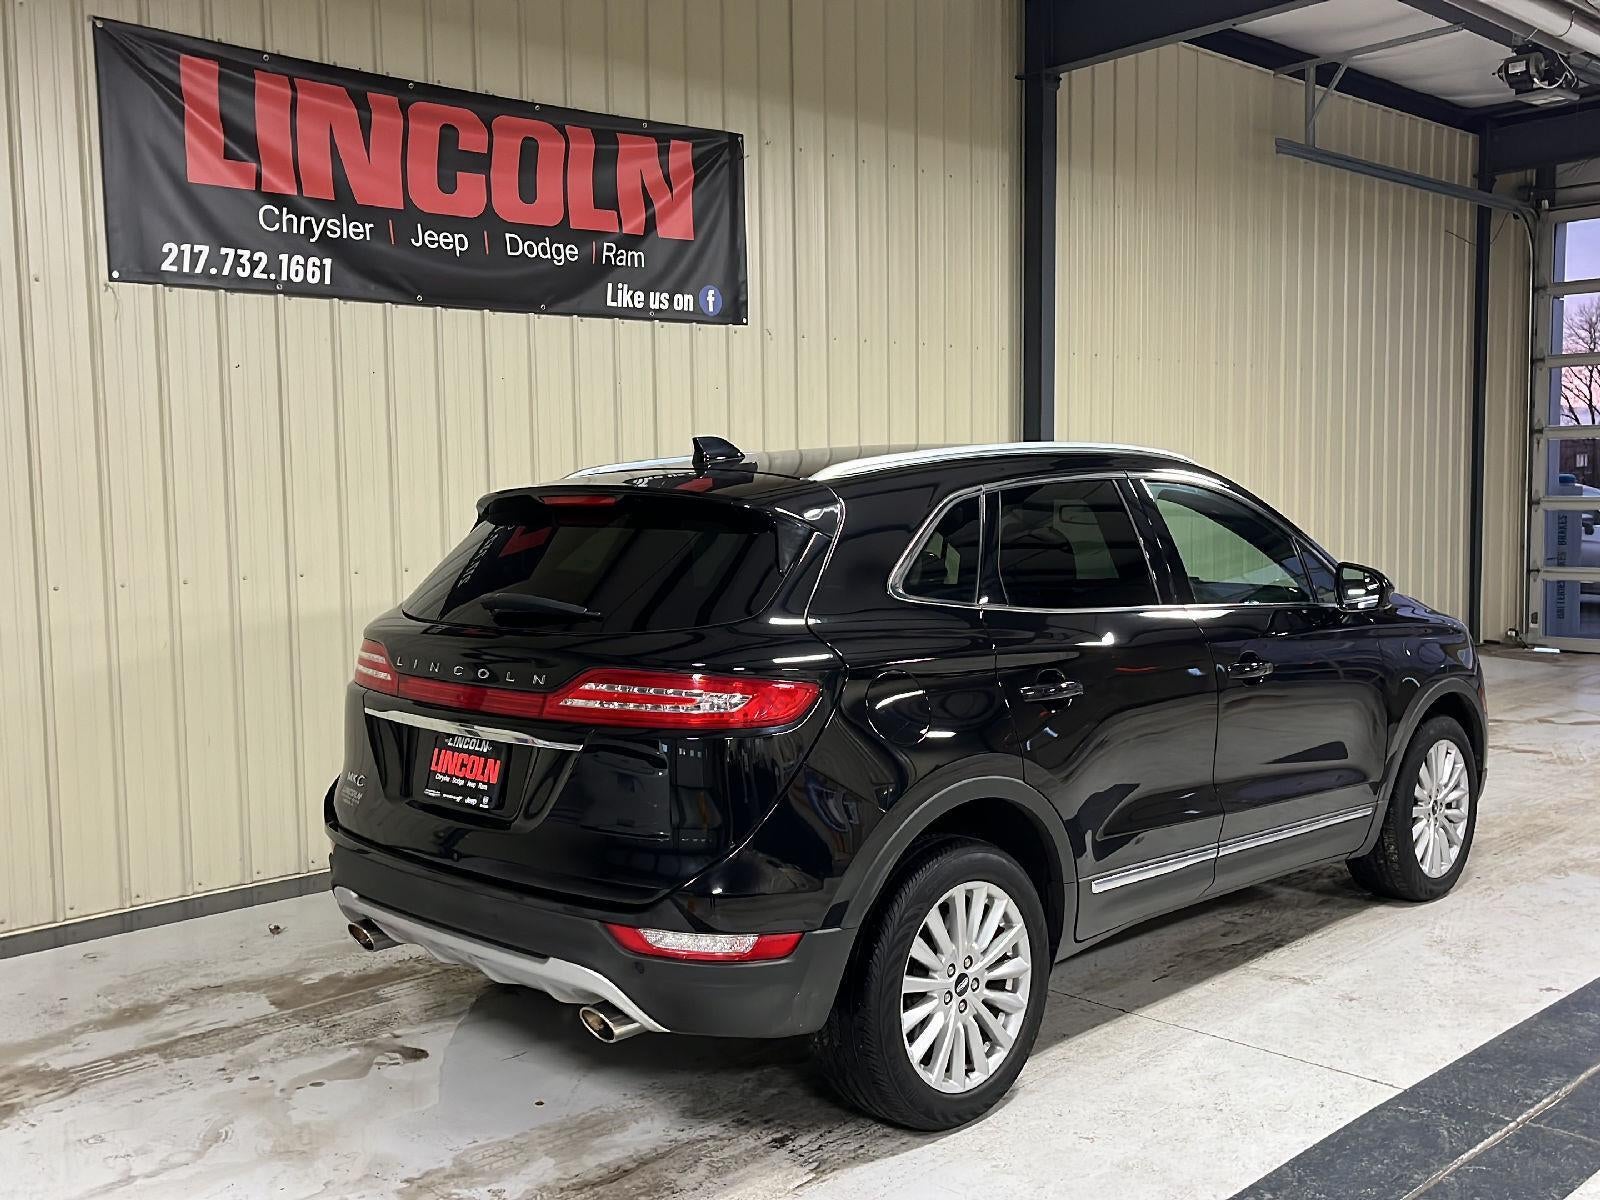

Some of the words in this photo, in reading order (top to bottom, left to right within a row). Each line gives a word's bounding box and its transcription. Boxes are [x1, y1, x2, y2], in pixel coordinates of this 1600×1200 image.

[178, 53, 695, 240] LINCOLN
[258, 204, 374, 243] Chrysler
[410, 223, 469, 257] Jeep
[504, 232, 579, 266] Dodge
[602, 242, 645, 268] Ram
[160, 242, 333, 285] 217.732.1661
[606, 282, 645, 309] Like
[649, 291, 670, 310] us
[673, 293, 694, 312] on
[396, 656, 546, 685] LINCOLN
[447, 736, 490, 753] LINCOLN
[430, 747, 501, 784] LINCOLN
